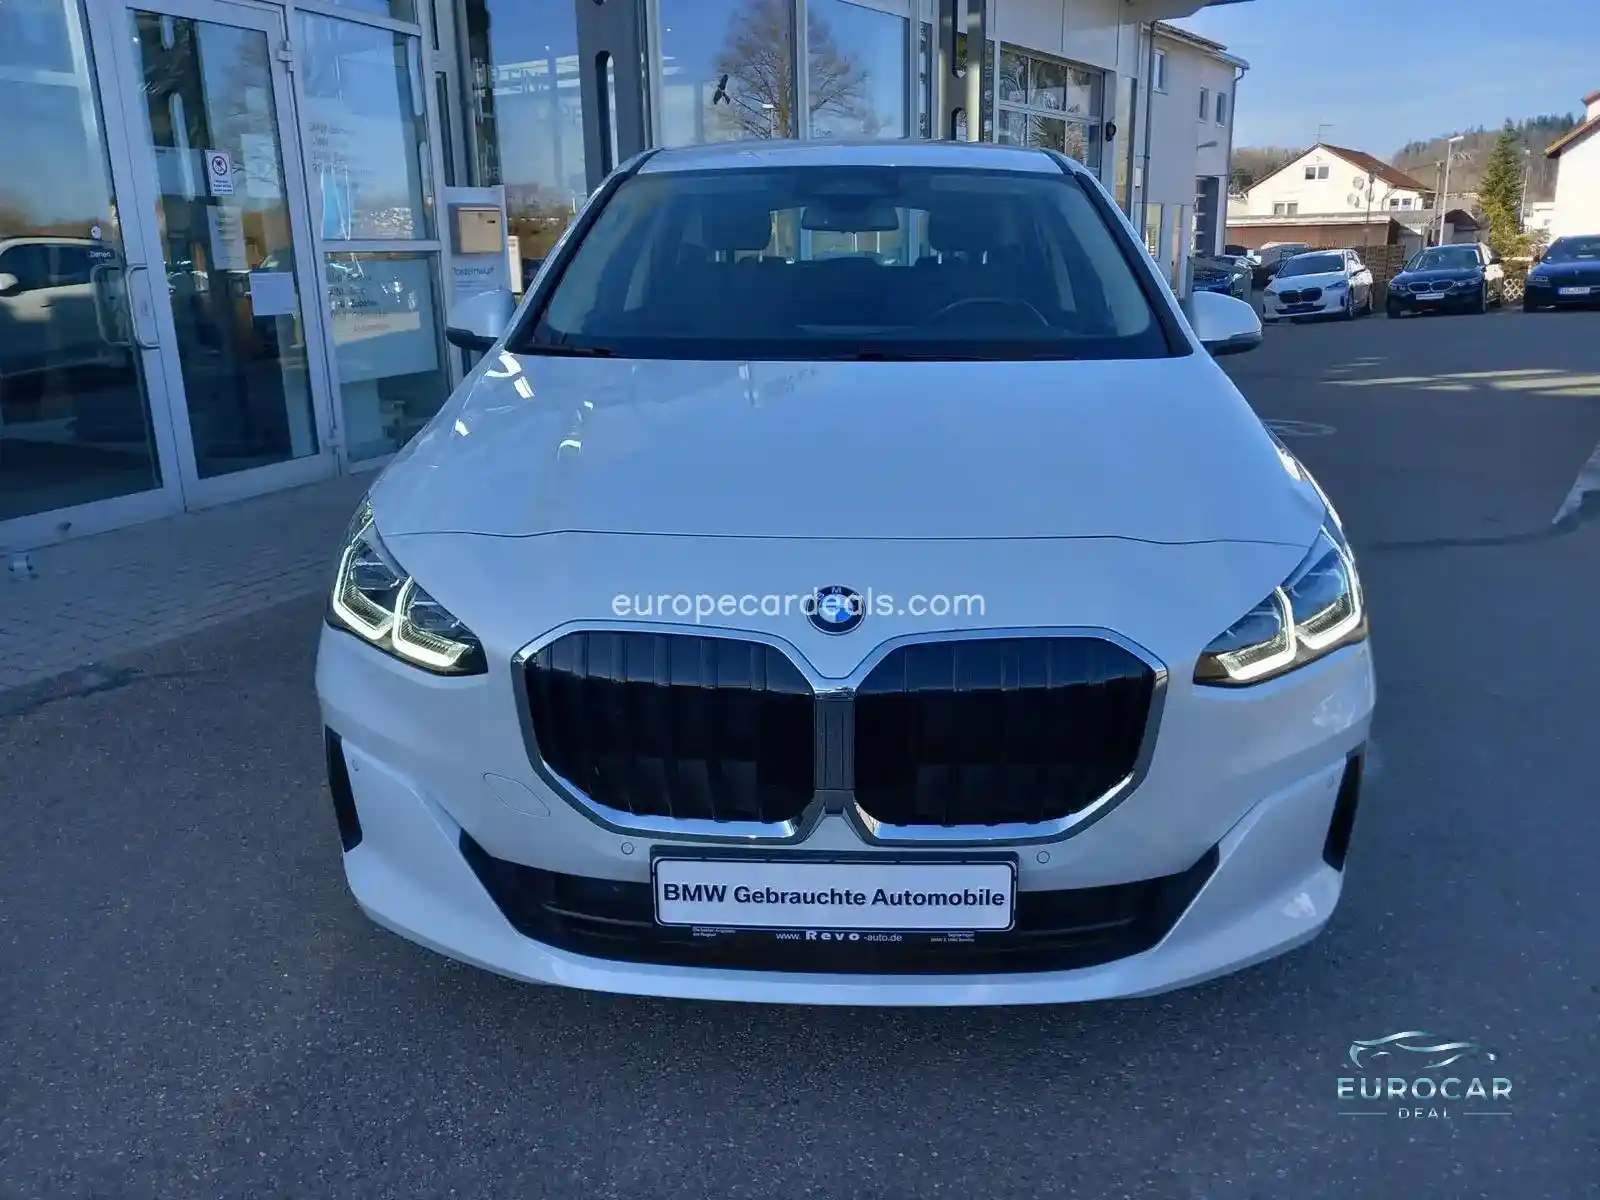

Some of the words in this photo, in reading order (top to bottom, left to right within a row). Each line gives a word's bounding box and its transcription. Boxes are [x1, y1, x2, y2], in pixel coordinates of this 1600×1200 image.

[663, 883, 726, 903] BMW
[733, 885, 866, 906] Gebrauchte
[871, 887, 1005, 907] Automobile
[776, 932, 800, 941] www.
[805, 931, 860, 941] Revo
